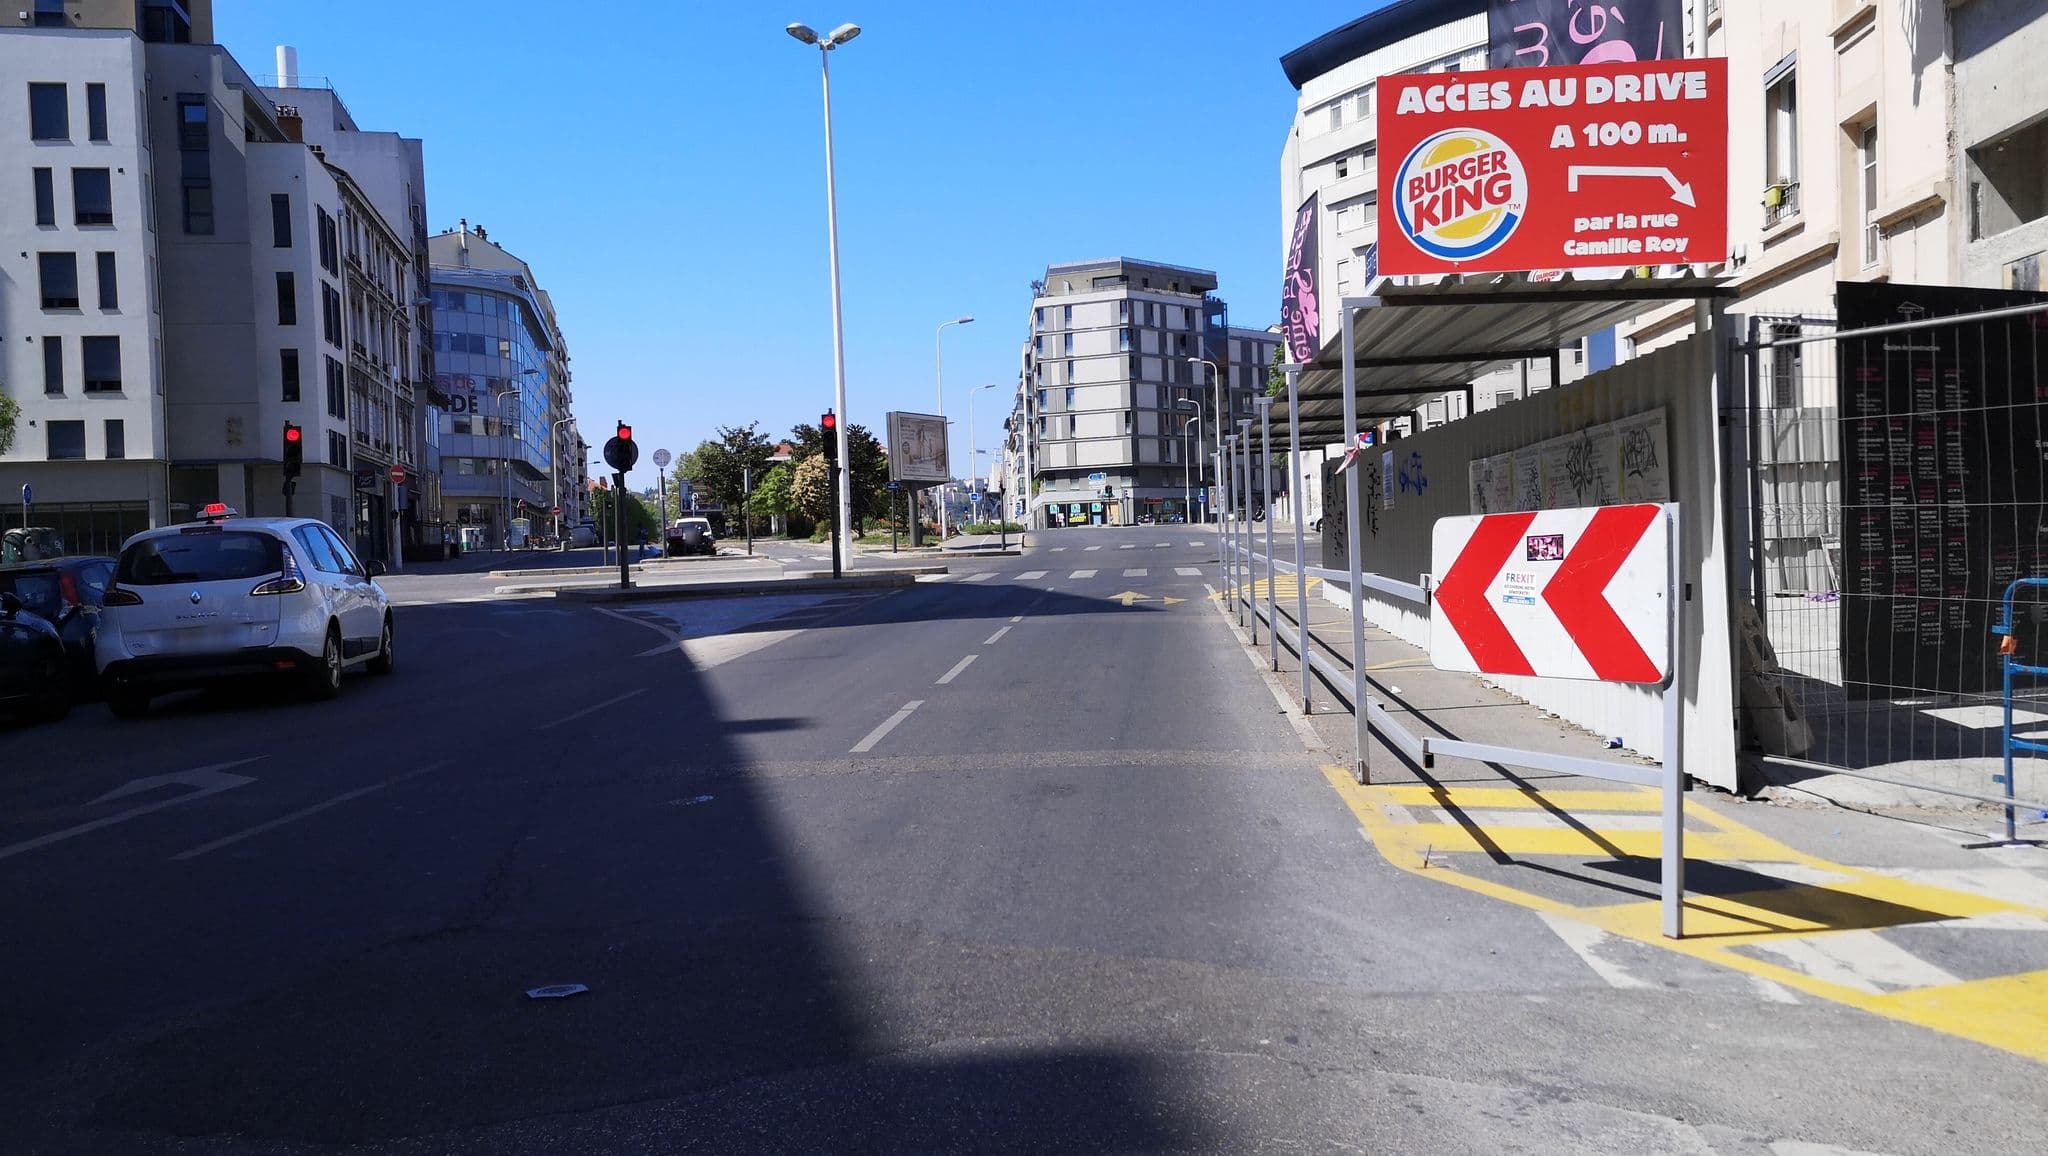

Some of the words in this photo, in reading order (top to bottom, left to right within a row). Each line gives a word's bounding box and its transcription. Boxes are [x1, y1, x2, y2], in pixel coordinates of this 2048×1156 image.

[1396, 81, 1512, 115] ACCES
[1519, 78, 1577, 108] AU
[1586, 71, 1707, 104] DRIVE
[1550, 124, 1575, 149] A
[1582, 121, 1642, 147] 100
[1648, 123, 1687, 144] m.
[1409, 150, 1508, 203] BURGER
[1414, 172, 1512, 235] KING
[1574, 216, 1613, 233] par
[1616, 213, 1637, 229] la
[1641, 213, 1679, 228] rue
[1563, 237, 1642, 256] Camille
[1645, 236, 1689, 253] Roy
[1505, 572, 1535, 584] FREXIT
